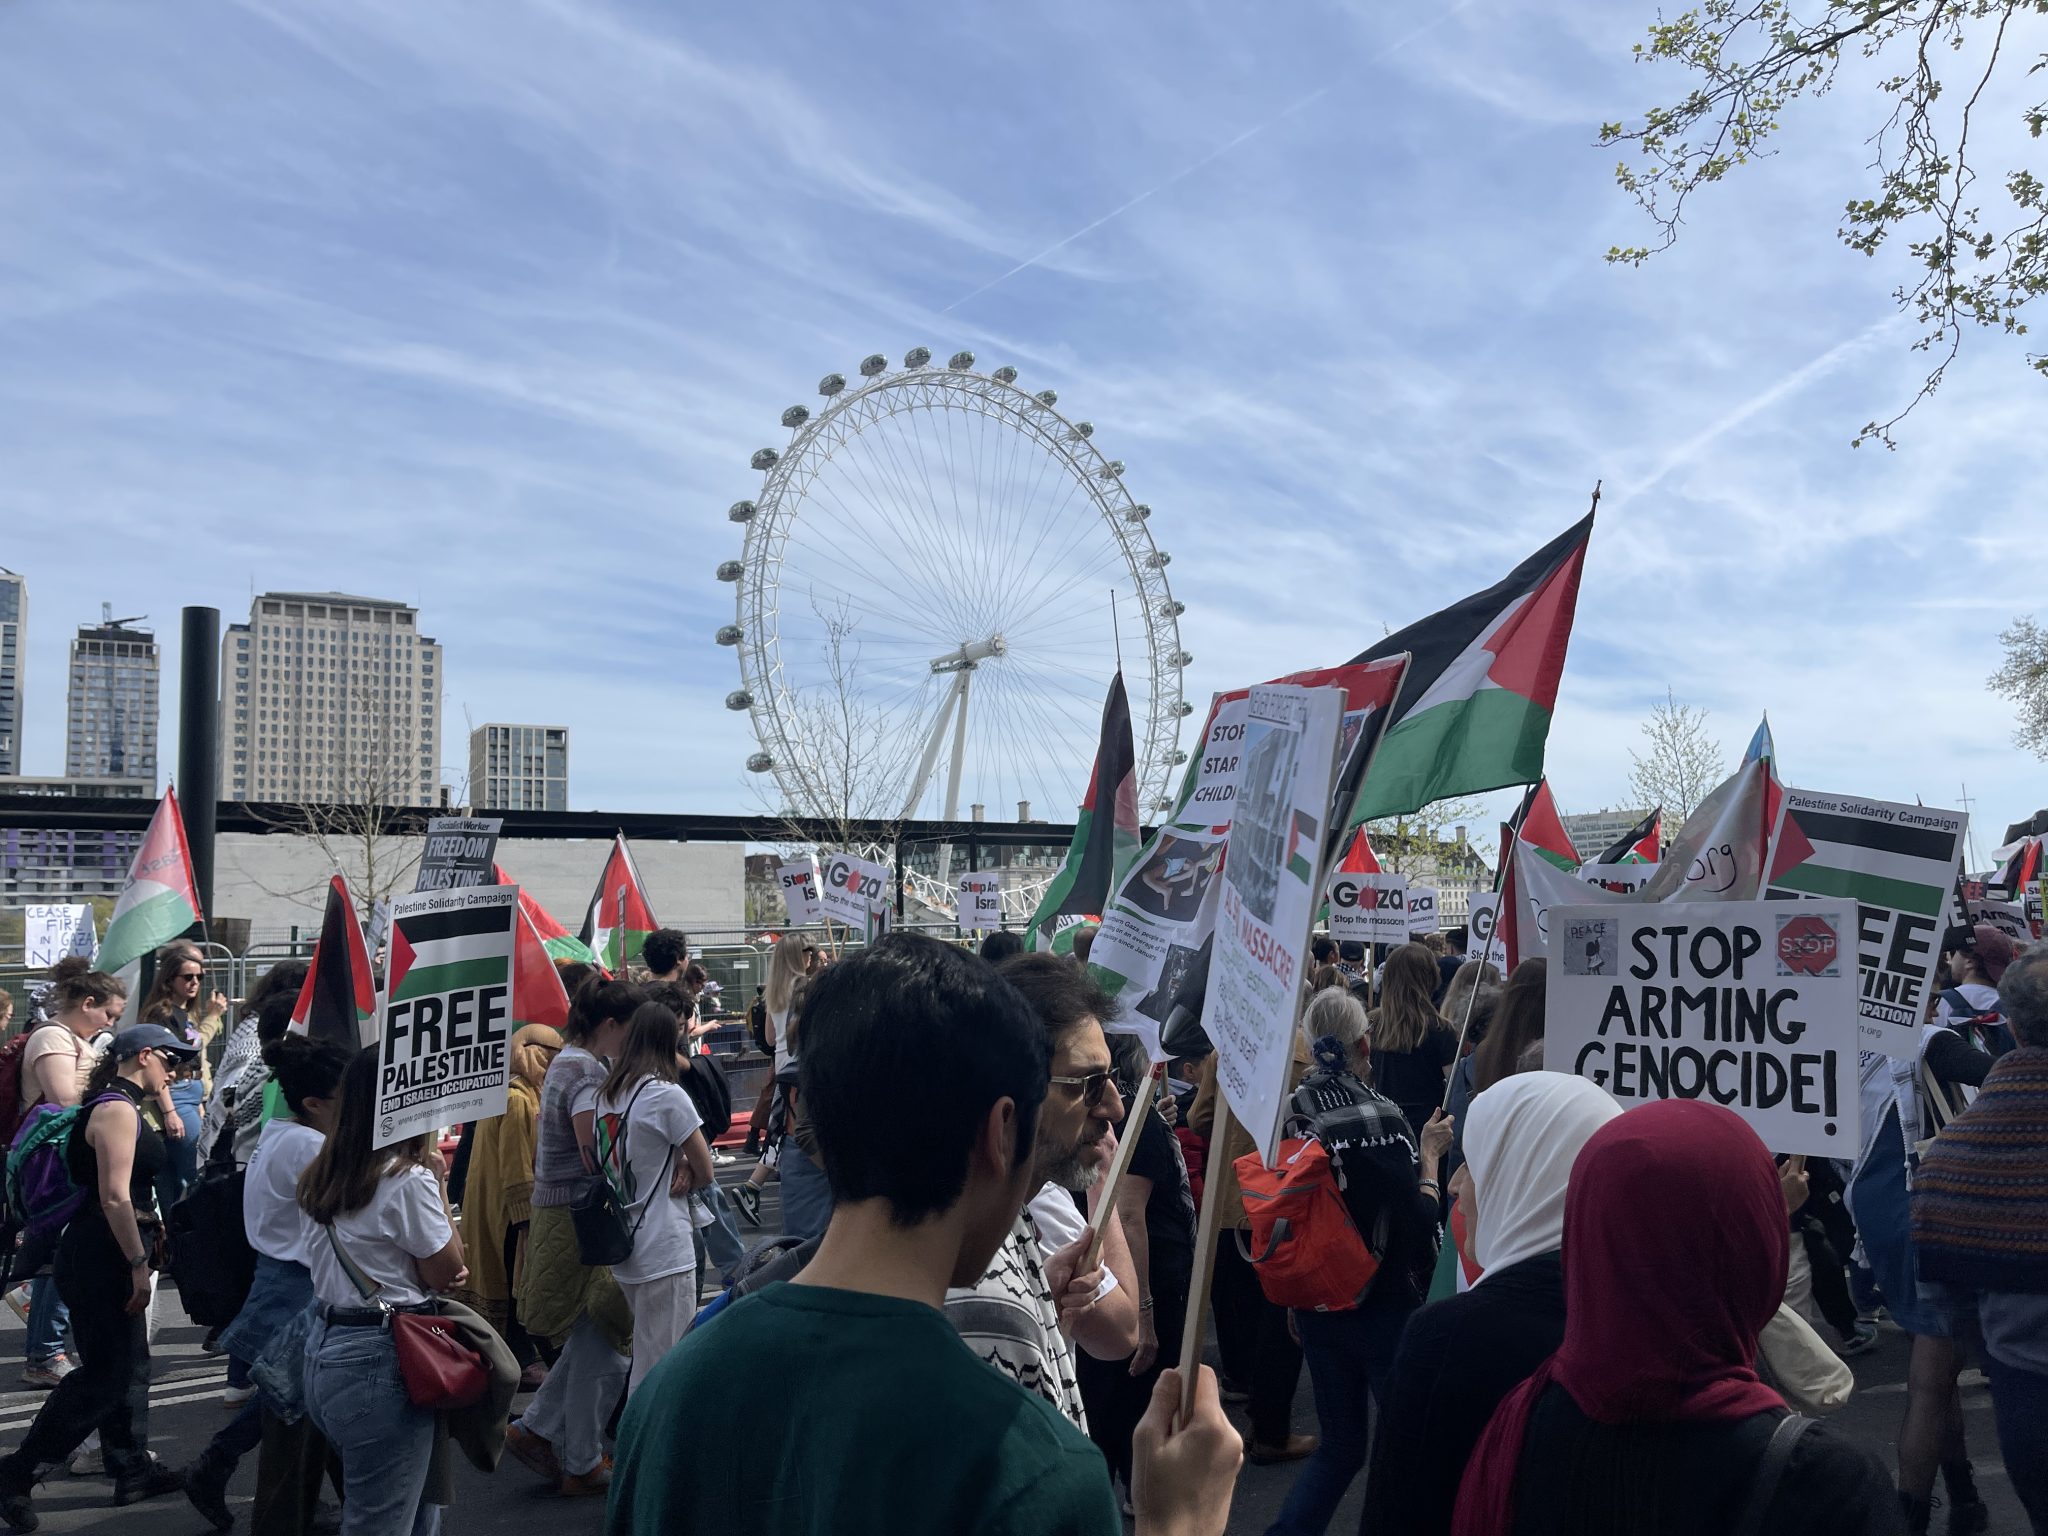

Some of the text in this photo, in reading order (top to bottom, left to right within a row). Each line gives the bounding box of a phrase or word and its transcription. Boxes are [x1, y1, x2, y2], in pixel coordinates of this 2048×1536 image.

[1204, 757, 1241, 774] STAR
[1788, 795, 1959, 830] Palestine Solidarity Campaign
[436, 821, 490, 831] Socialist Worker
[427, 836, 490, 859] FREEDOM
[417, 868, 486, 891] PALESTINE
[394, 892, 513, 915] Palestine Solidarity Campaign
[825, 891, 840, 904] Stop
[1408, 897, 1433, 912] za
[26, 906, 72, 919] CEASE
[1334, 914, 1405, 926] Stop the massacre
[46, 918, 83, 932] FIRE
[1570, 924, 1607, 939] PEACE
[40, 935, 52, 945] IN
[61, 931, 93, 946] GAZA
[1118, 939, 1135, 949] since
[1780, 936, 1836, 954] STOP
[1492, 951, 1505, 962] the
[1629, 925, 1762, 980] STOP
[1597, 985, 1807, 1045] ARMING
[1860, 1002, 1914, 1026] PATION
[384, 985, 508, 1066] FREE
[382, 1042, 506, 1097] PALESTINE
[382, 1073, 503, 1114] END ISRAELI OCCUPATION
[1574, 1041, 1838, 1136] GENOCIDE!
